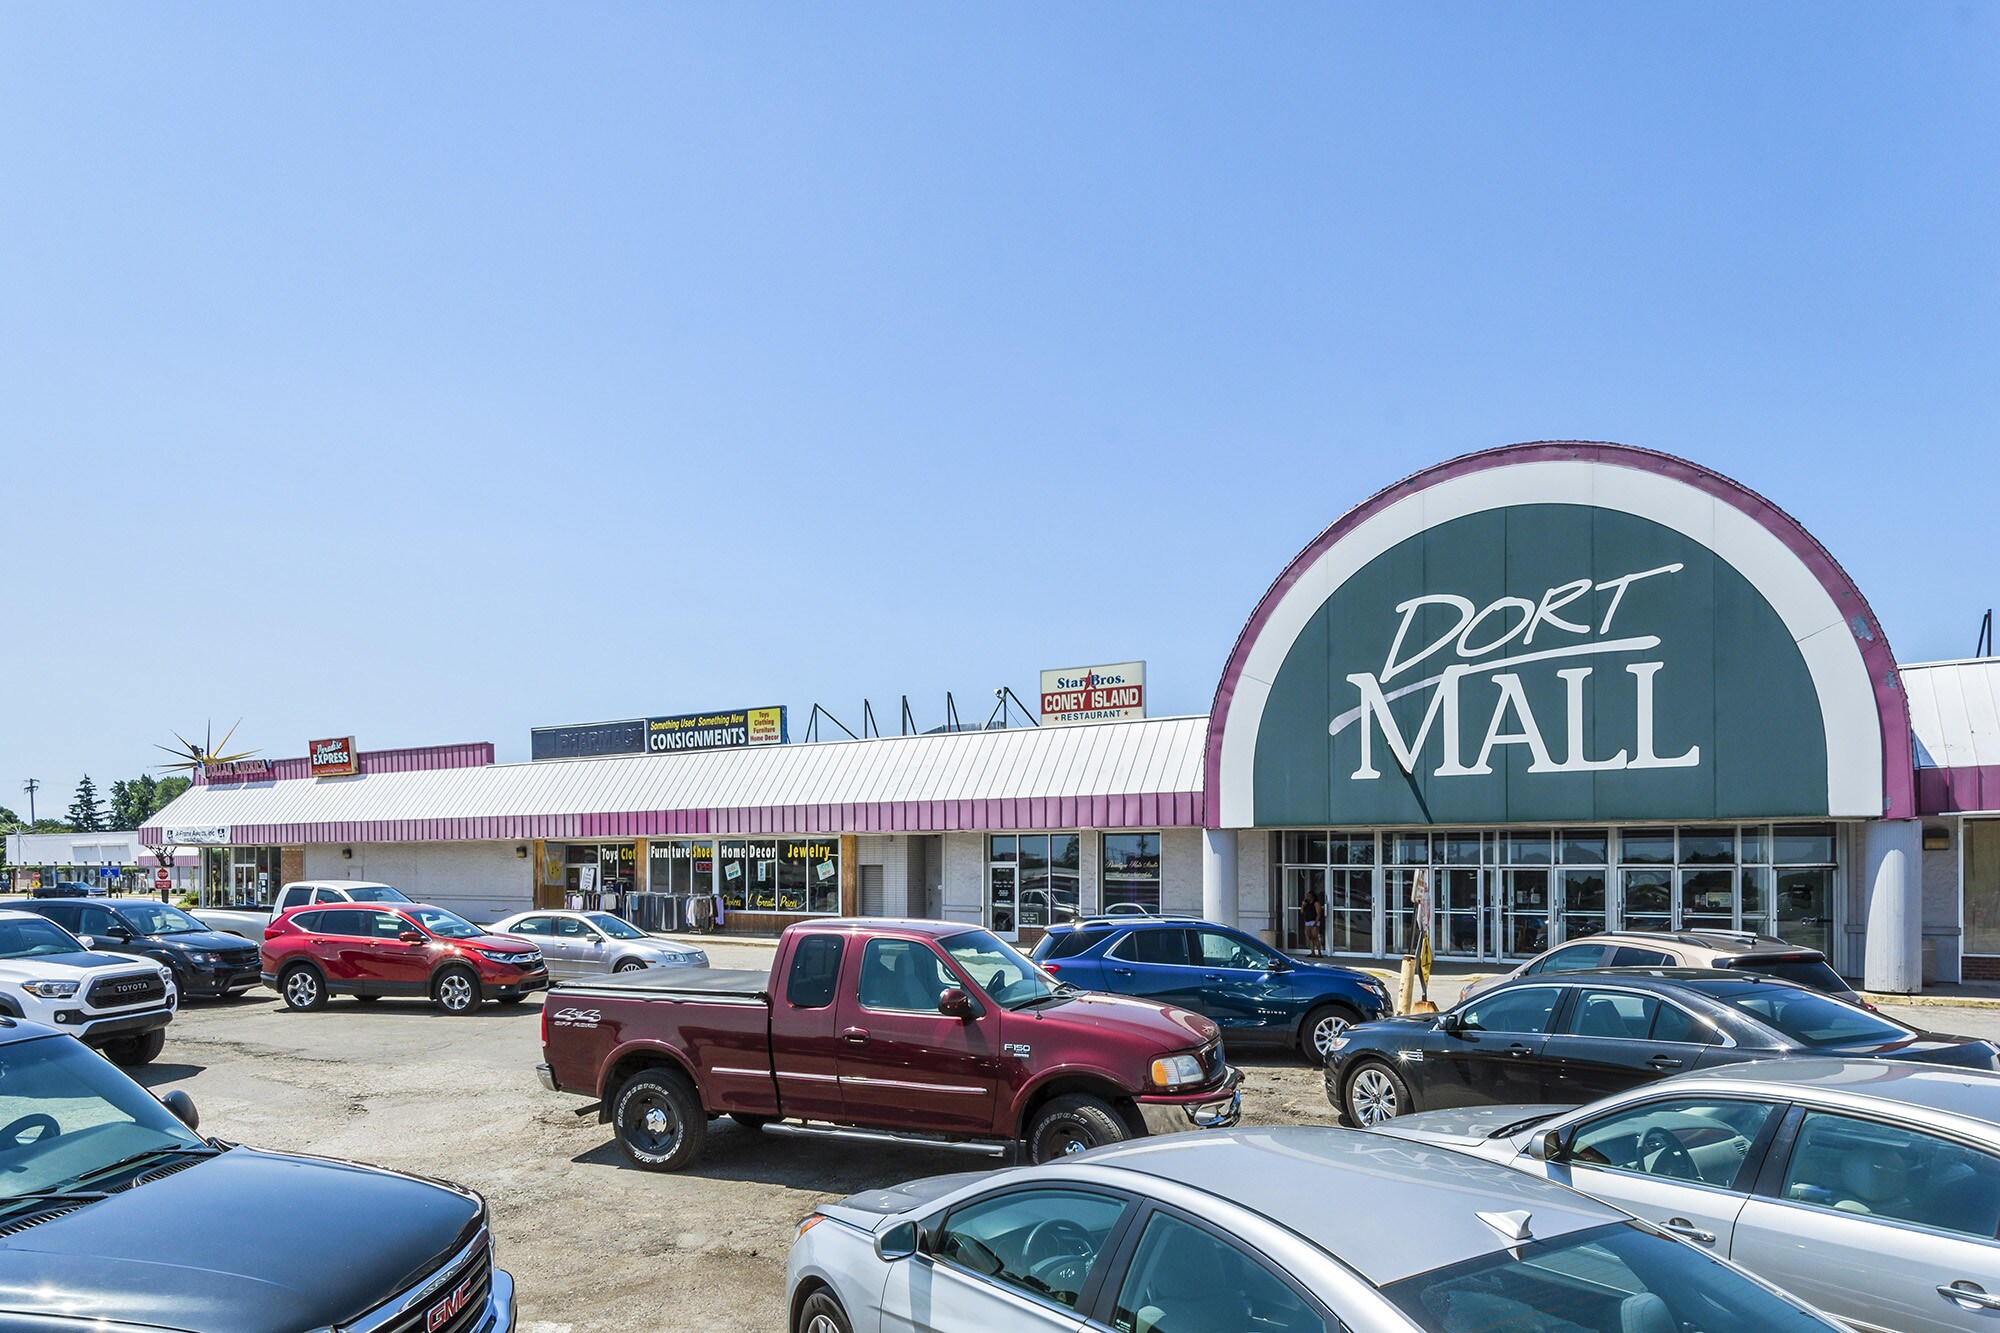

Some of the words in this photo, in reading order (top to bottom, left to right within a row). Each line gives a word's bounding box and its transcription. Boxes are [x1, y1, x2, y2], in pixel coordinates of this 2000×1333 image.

[1379, 562, 1684, 683] DORT
[1057, 677, 1085, 689] Star
[1090, 673, 1125, 686] Bros.
[1044, 692, 1087, 712] CONEY
[1091, 688, 1139, 708] ISLAND
[650, 719, 679, 731] Something
[680, 717, 696, 728] Used
[697, 715, 730, 727] Something
[731, 713, 745, 723] New
[754, 718, 775, 726] Clothing
[1060, 709, 1121, 721] RESTAURANT
[1345, 661, 1700, 780] MALL
[753, 726, 776, 734] Furniture
[650, 727, 745, 751] CONSIGNMENTS
[312, 751, 349, 765] EXPRESS
[601, 848, 618, 863] Toys
[650, 845, 691, 859] Furniture
[721, 844, 746, 858] Home
[749, 844, 776, 858] Decor
[787, 844, 830, 861] Jewelry
[756, 895, 775, 907] Great
[779, 895, 797, 907] Prices
[117, 982, 148, 992] TOYOTA
[427, 1277, 471, 1333] GMC
